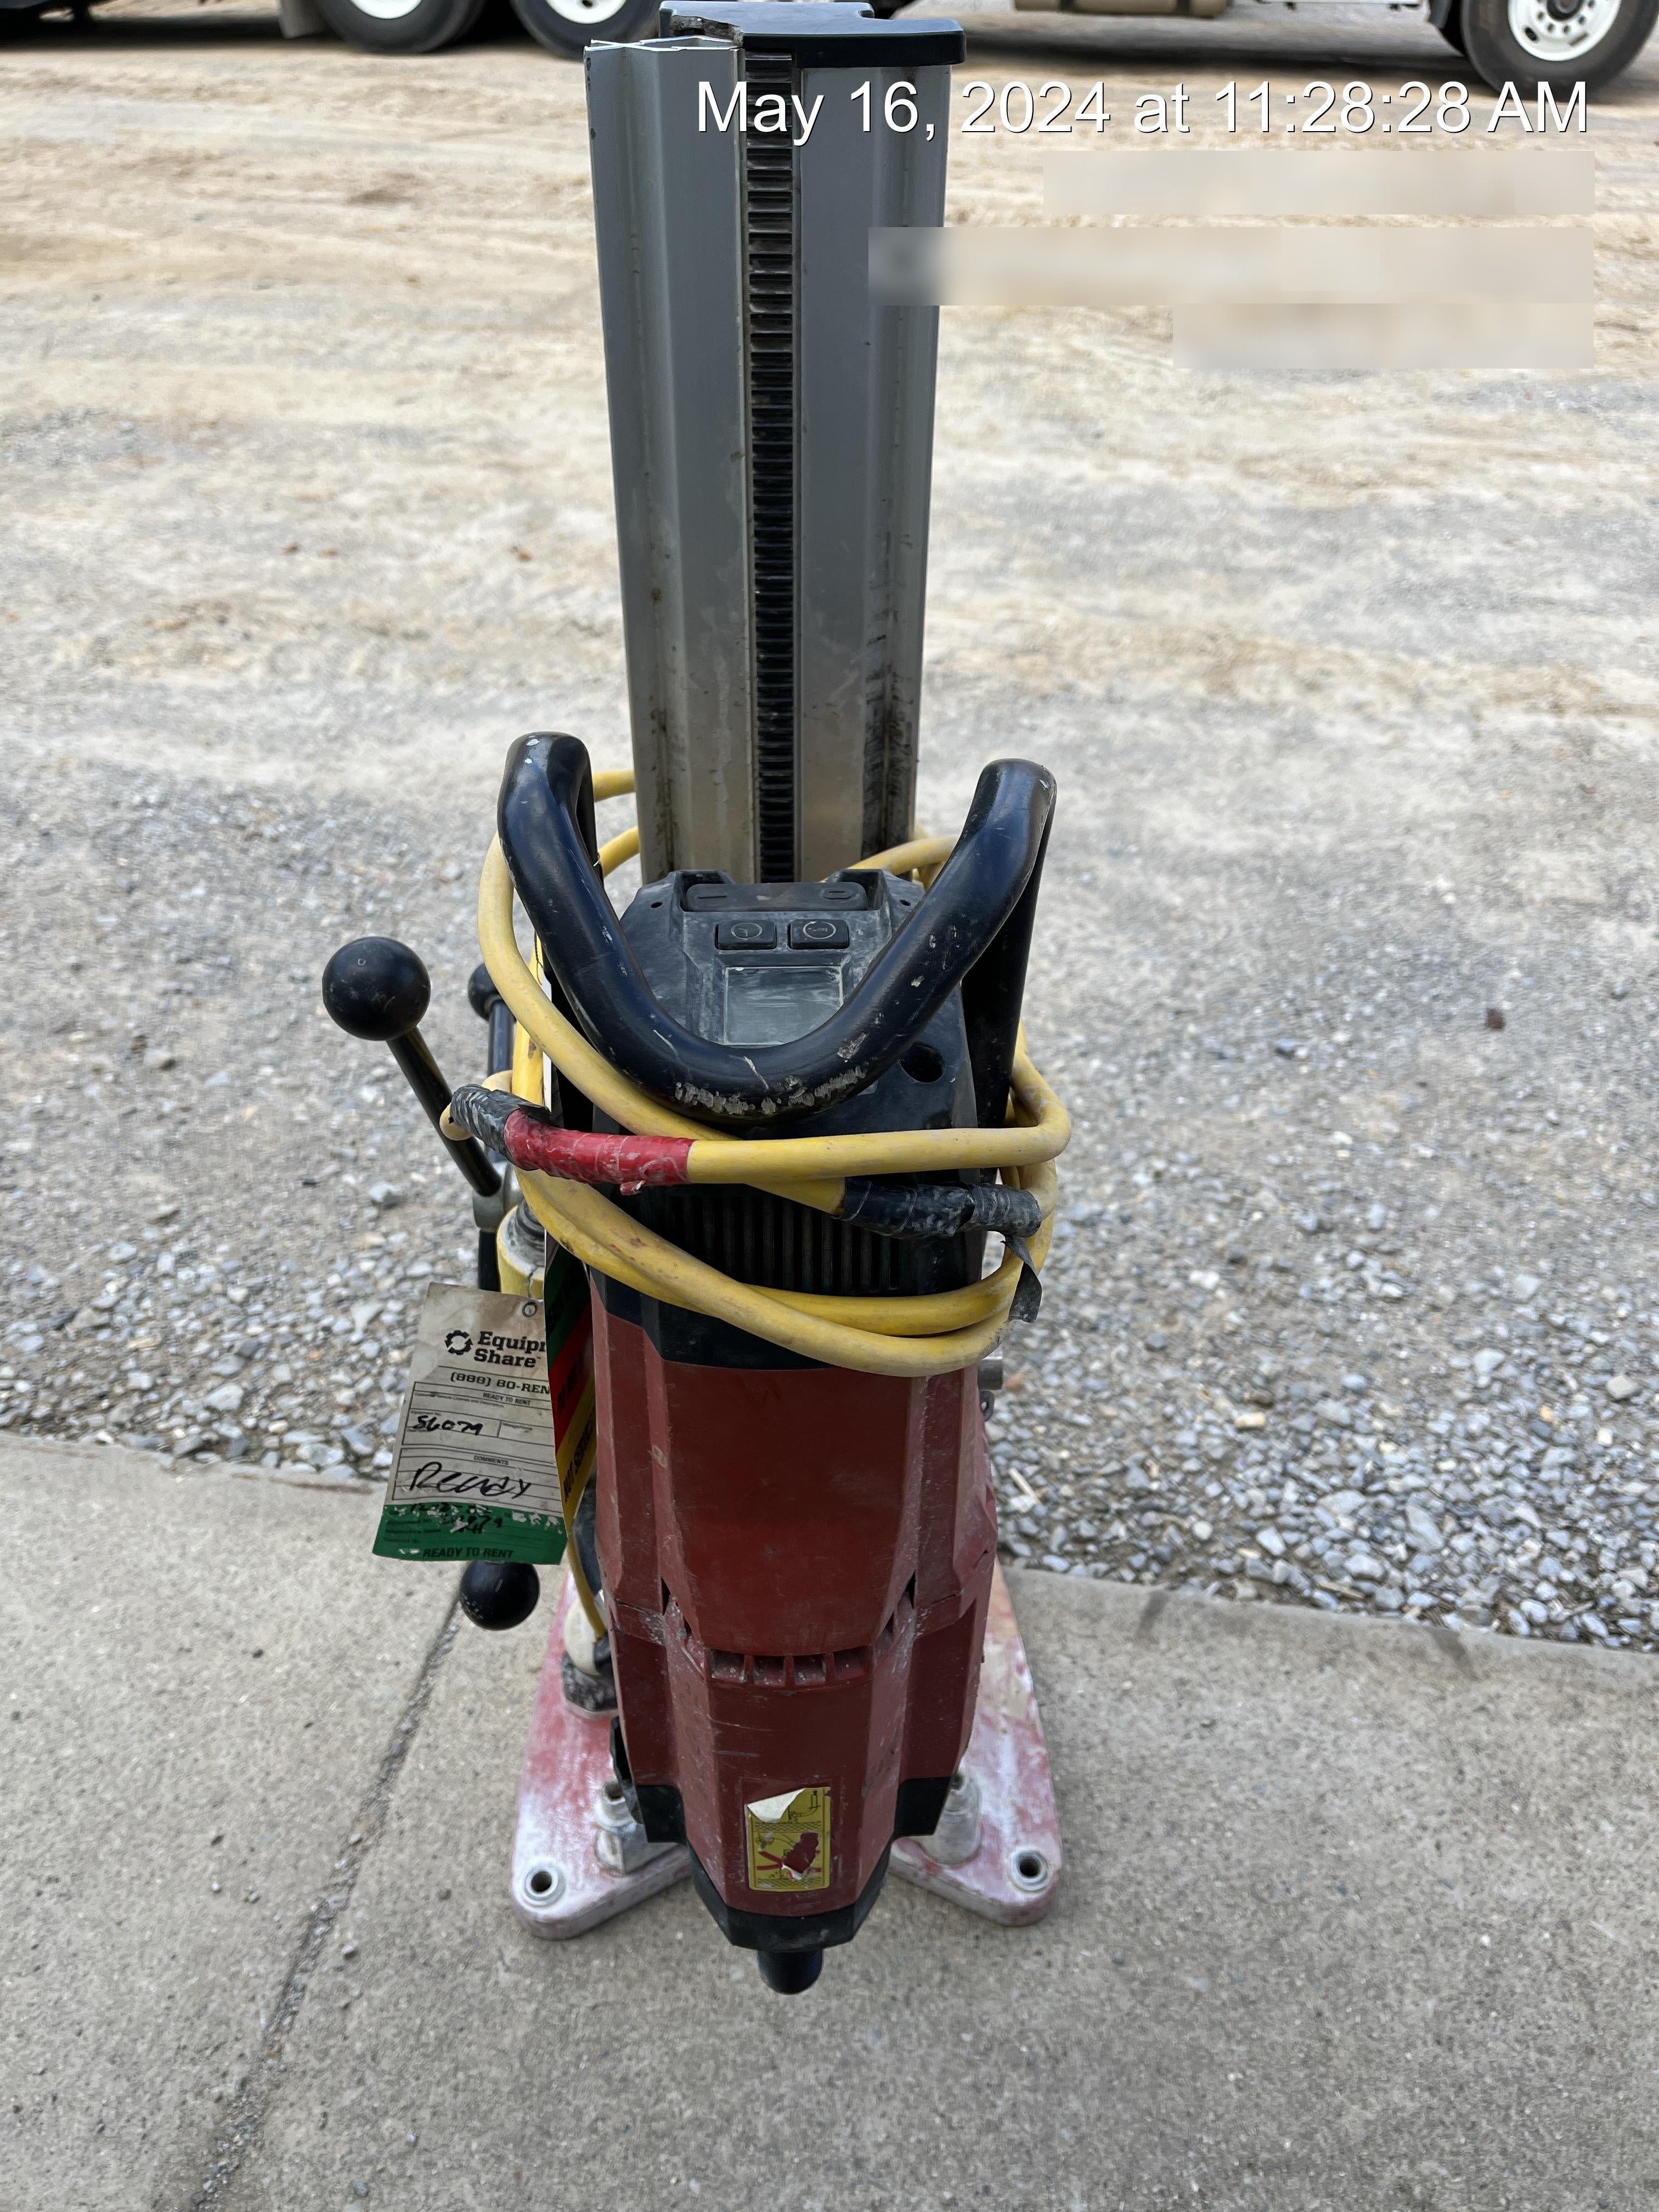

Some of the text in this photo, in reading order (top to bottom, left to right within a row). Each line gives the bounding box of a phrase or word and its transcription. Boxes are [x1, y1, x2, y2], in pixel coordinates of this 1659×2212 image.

[474, 1348, 536, 1368] Share
[450, 1372, 492, 1387] (888)
[483, 1392, 504, 1402] READY
[473, 1455, 509, 1465] COMMENTS
[423, 1548, 515, 1558] READY TO RENT
